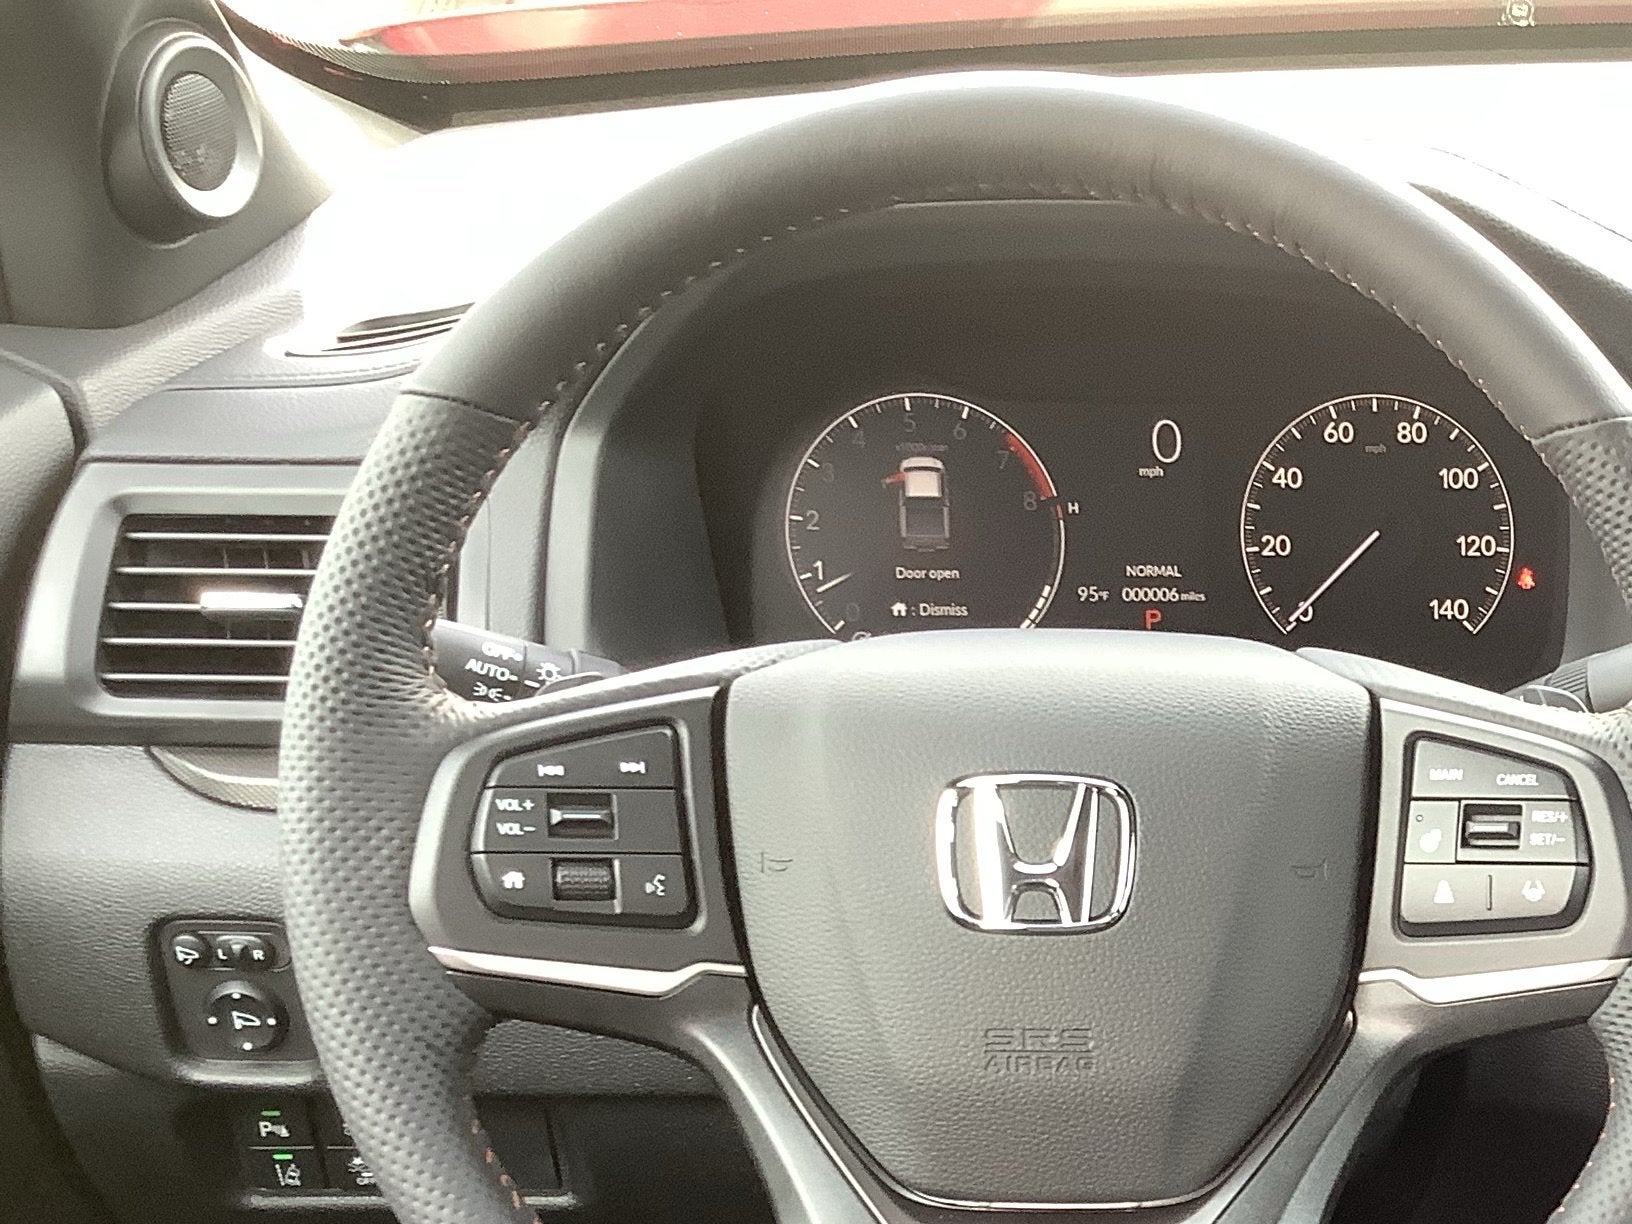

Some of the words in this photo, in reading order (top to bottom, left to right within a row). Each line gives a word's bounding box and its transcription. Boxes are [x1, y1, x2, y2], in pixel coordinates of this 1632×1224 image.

[1152, 419, 1182, 464] 0
[1324, 422, 1354, 444] 60
[1397, 422, 1427, 444] 80
[1139, 466, 1164, 479] mph
[1272, 467, 1303, 489] 40
[1438, 468, 1478, 490] 100
[1067, 502, 1080, 515] H
[806, 510, 820, 531] 2
[1261, 535, 1291, 557] 20
[1456, 535, 1496, 557] 120
[813, 560, 824, 580] 1
[895, 566, 927, 579] Door
[928, 569, 960, 581] open
[1125, 564, 1183, 578] NORMAL
[1121, 587, 1180, 602] 000006
[1180, 591, 1207, 602] miles
[919, 602, 969, 617] Dismiss
[1145, 609, 1162, 630] P
[1430, 599, 1469, 621] 140
[464, 658, 510, 681] AUTO
[1495, 773, 1539, 786] CANCEL
[217, 947, 230, 961] L
[252, 948, 266, 962] R
[984, 1026, 1093, 1049] SRS
